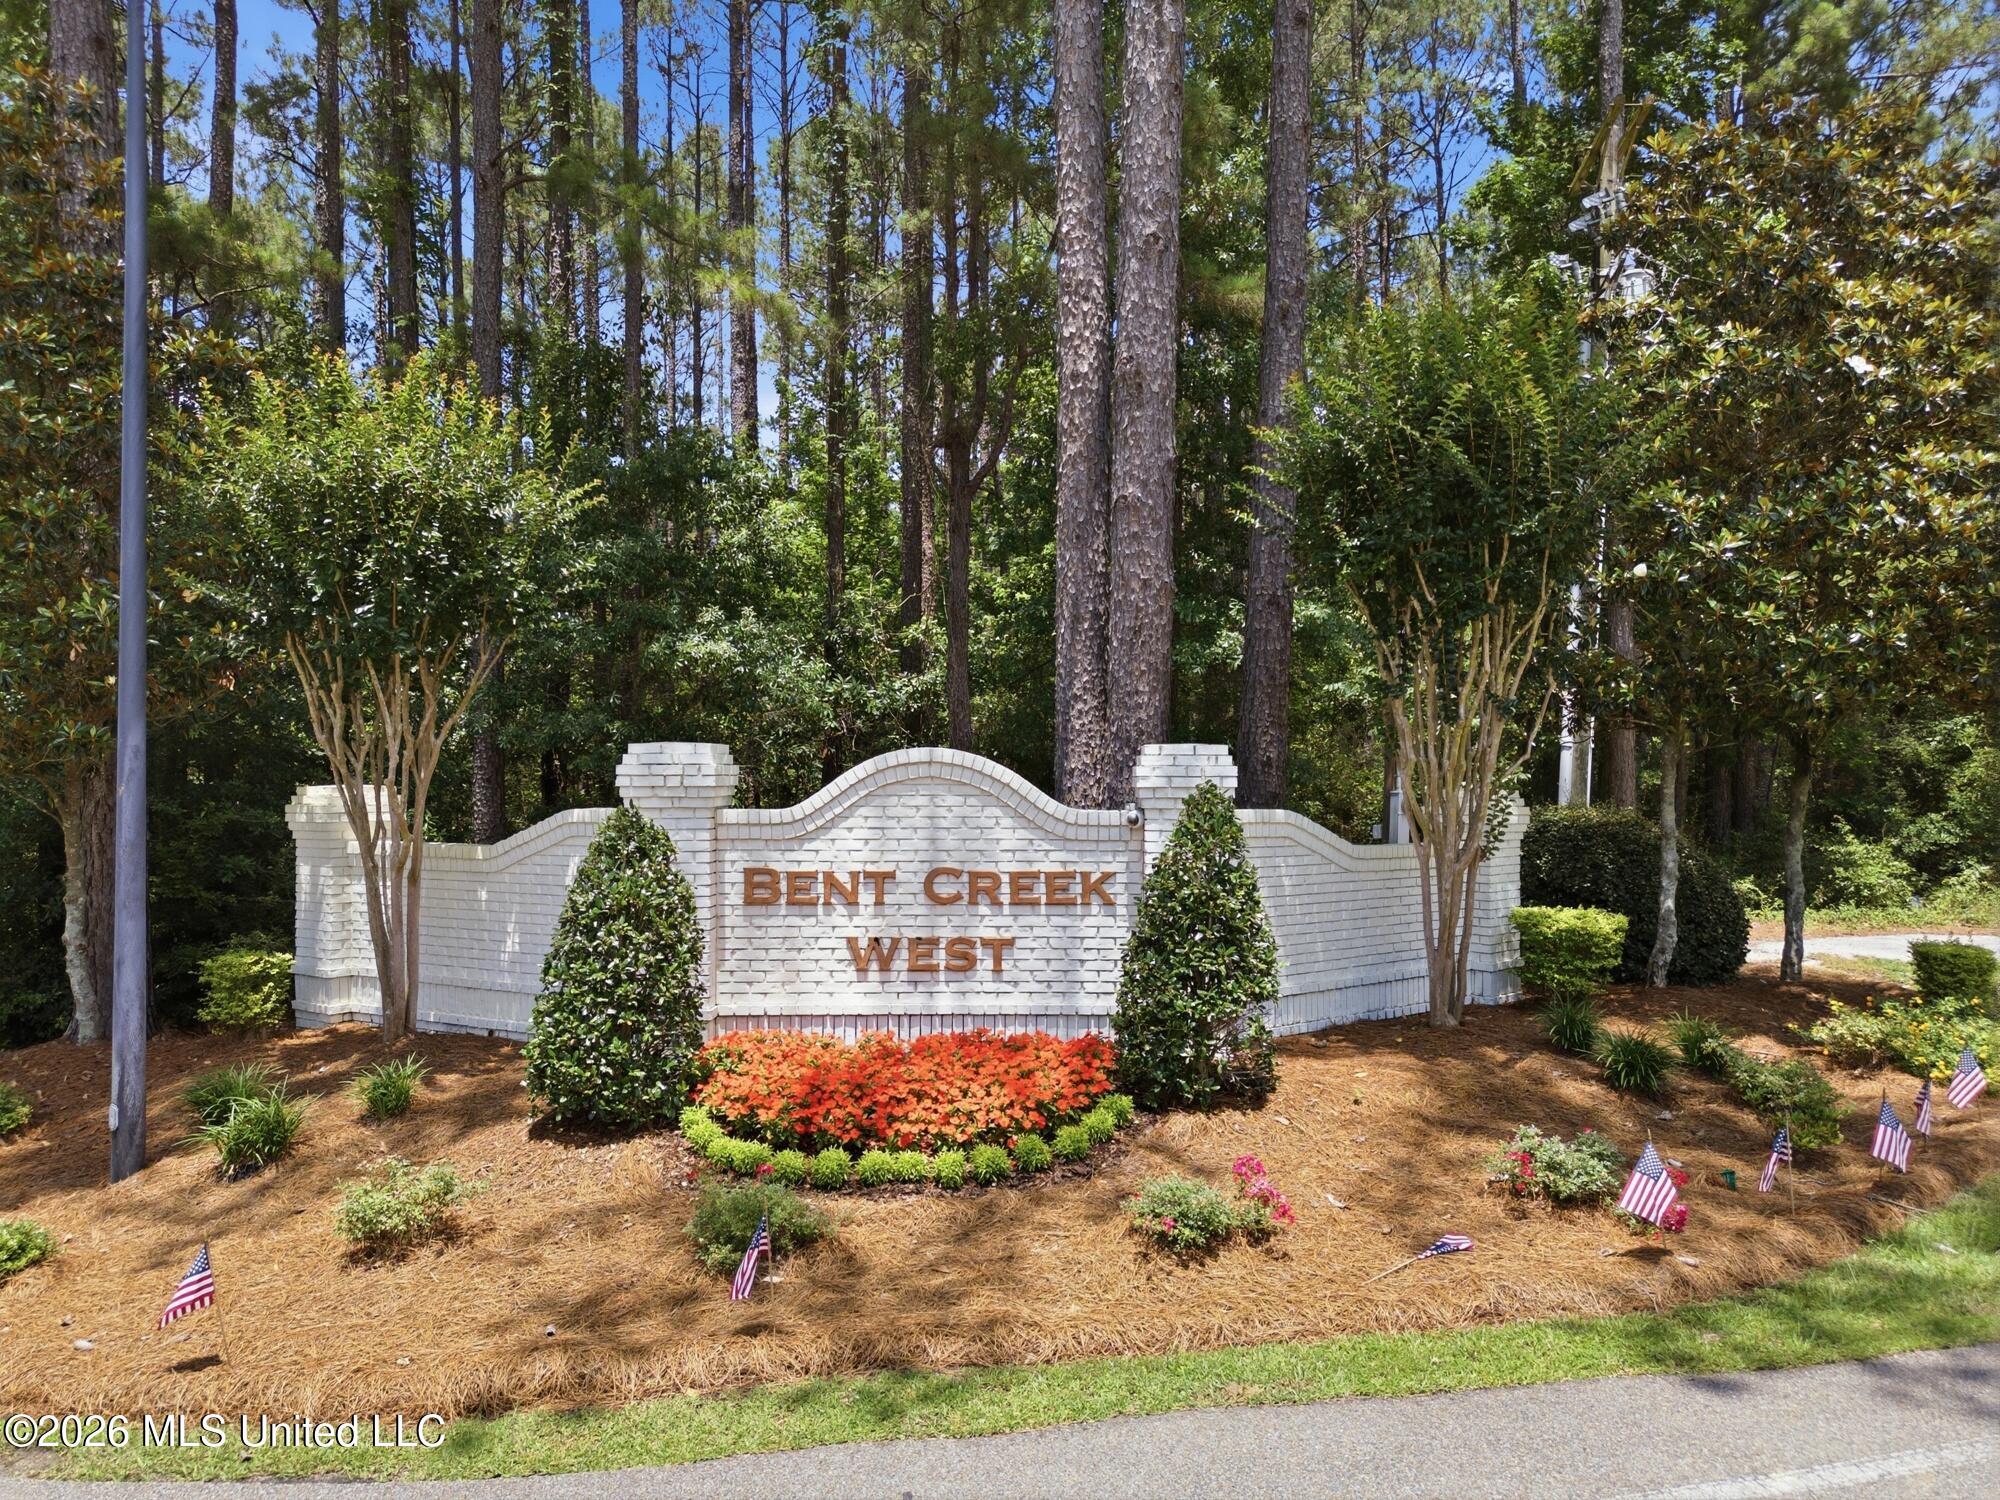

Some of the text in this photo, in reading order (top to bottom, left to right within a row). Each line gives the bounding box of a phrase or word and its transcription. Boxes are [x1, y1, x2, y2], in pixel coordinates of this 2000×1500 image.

[743, 867, 1117, 906] BENT CREEK
[847, 936, 1016, 973] WEST
